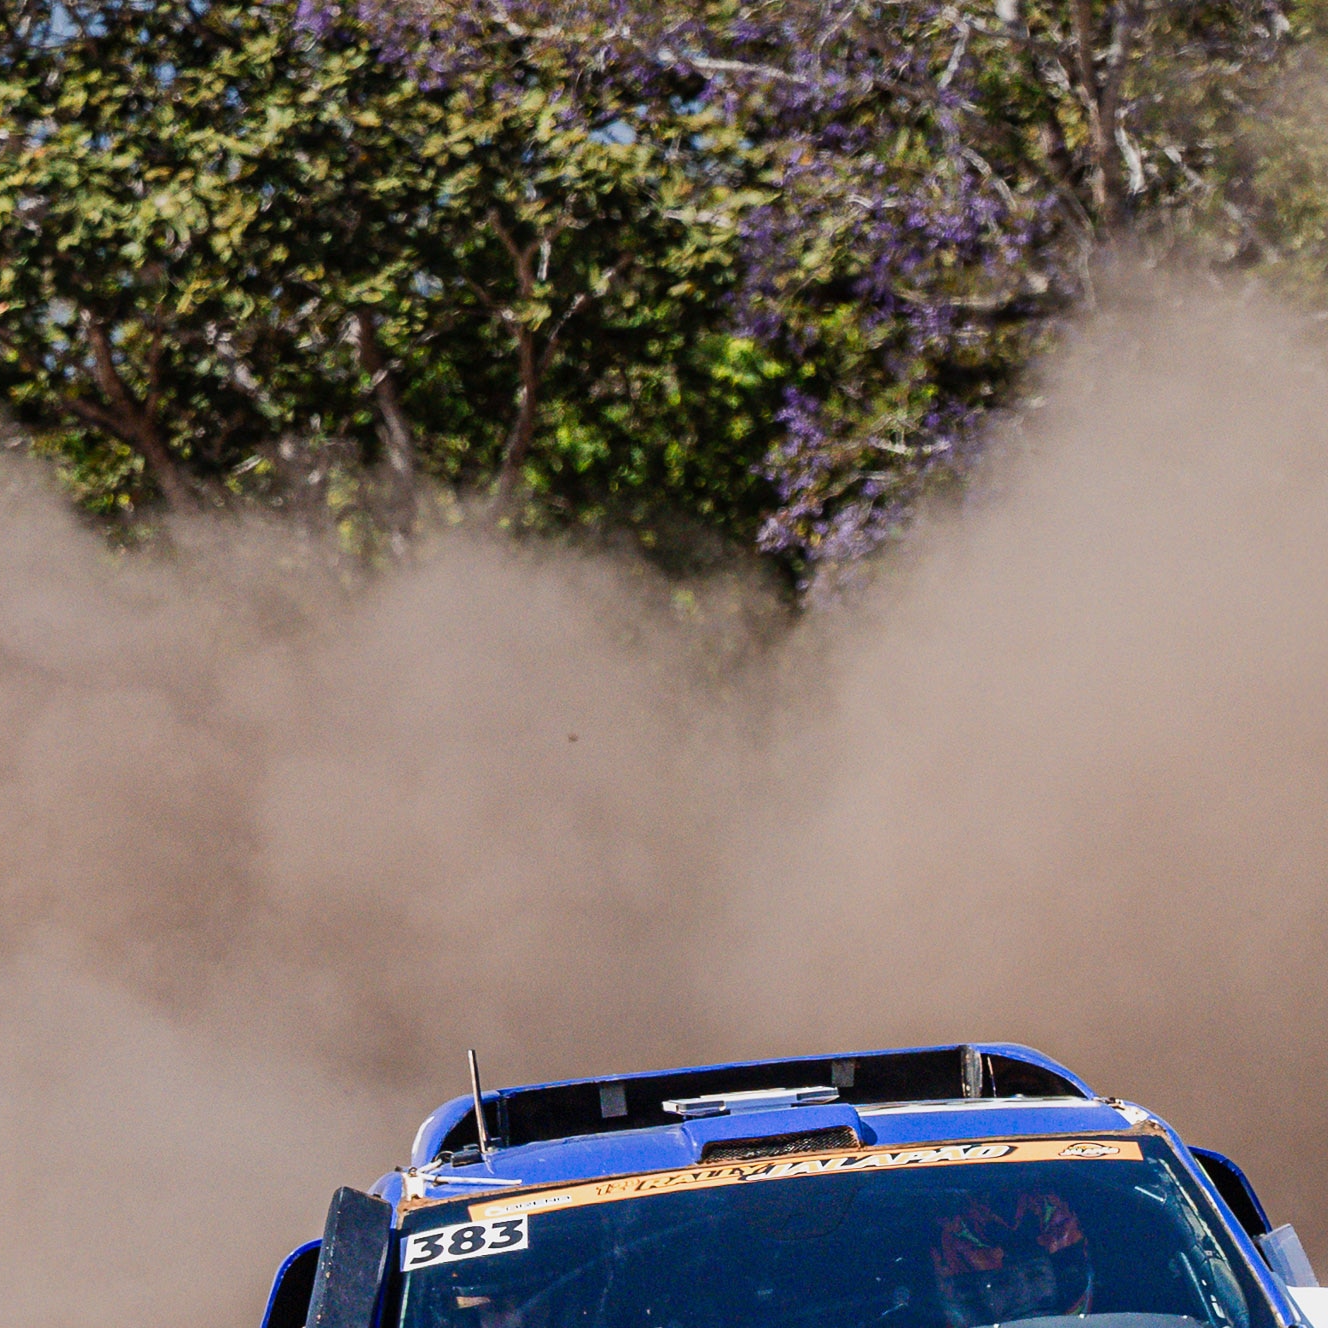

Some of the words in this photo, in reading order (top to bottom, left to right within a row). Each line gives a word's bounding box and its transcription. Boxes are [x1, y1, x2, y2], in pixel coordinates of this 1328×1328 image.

[634, 1164, 769, 1192] RALLY
[744, 1144, 1015, 1182] JALAPÃO
[413, 1219, 524, 1264] 383
